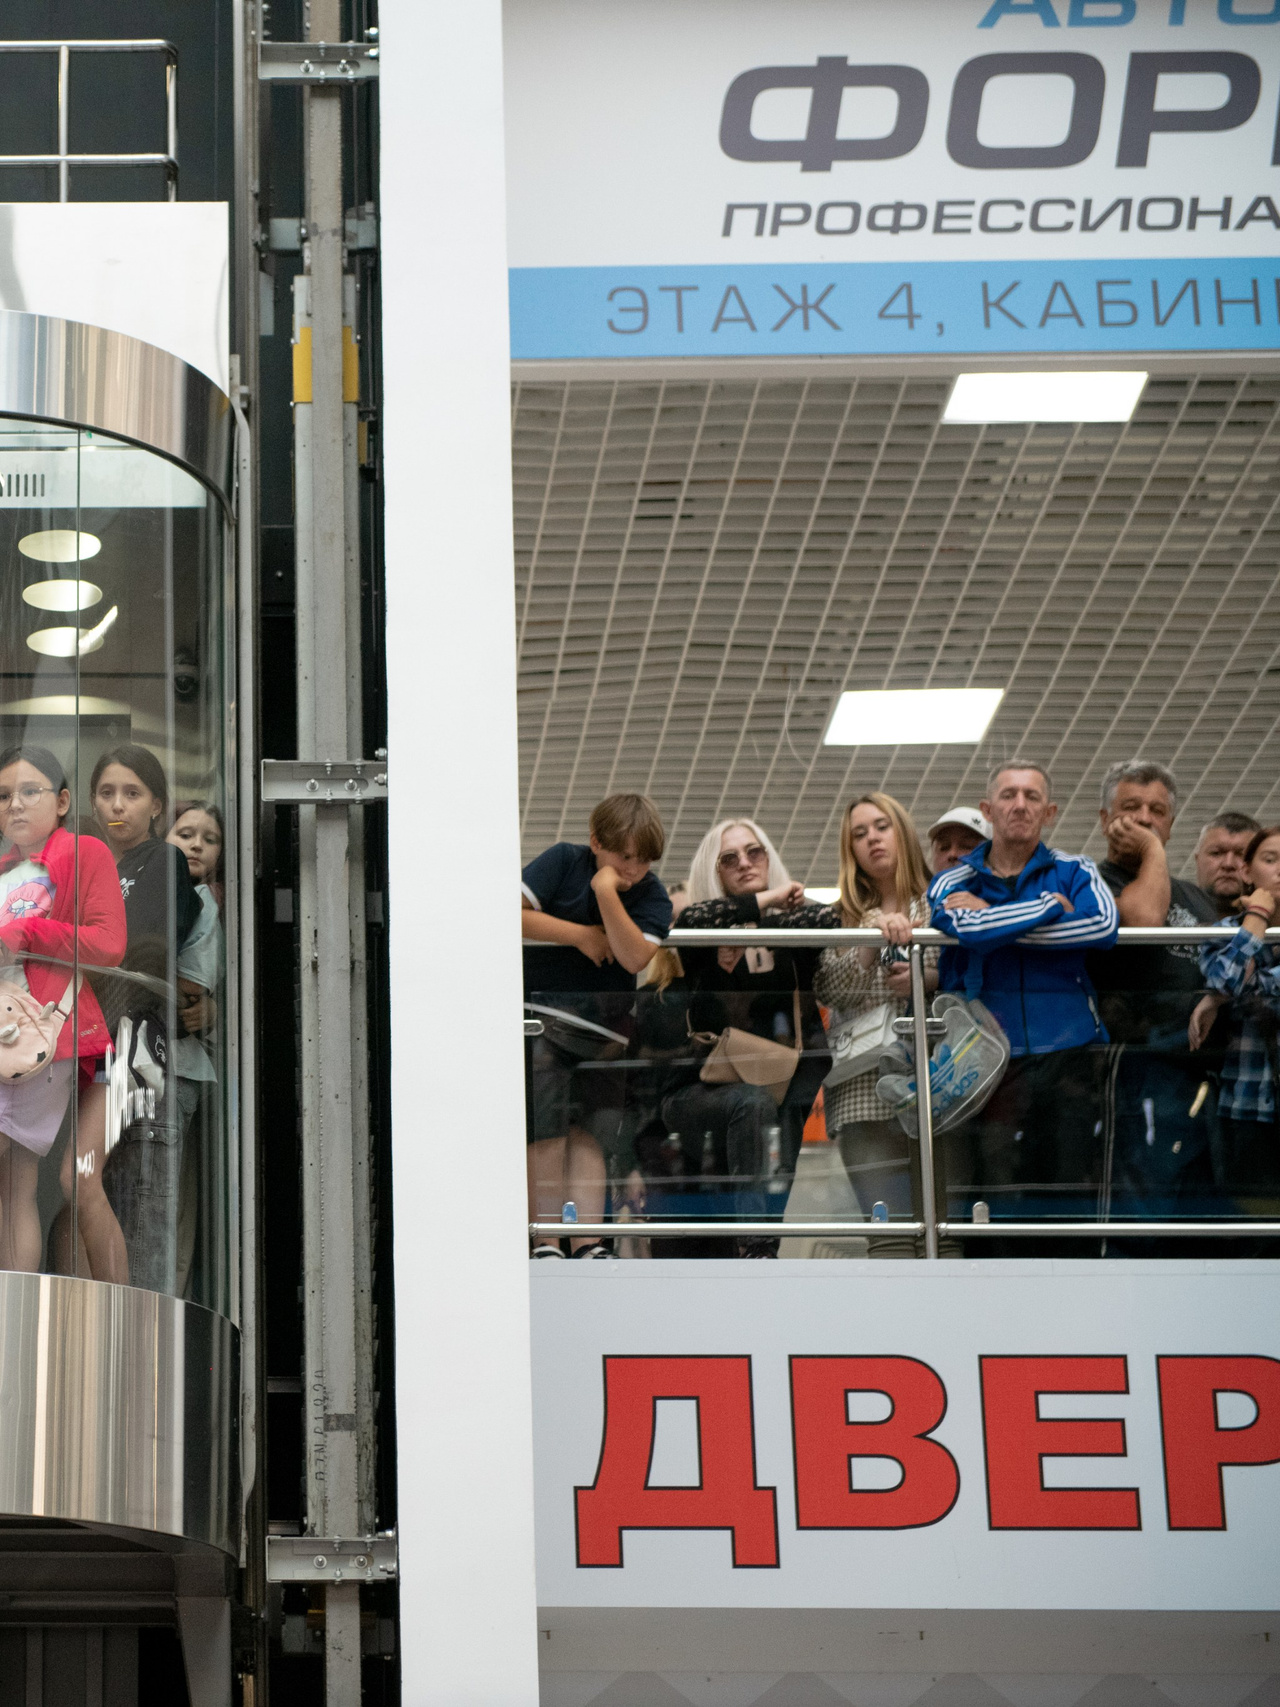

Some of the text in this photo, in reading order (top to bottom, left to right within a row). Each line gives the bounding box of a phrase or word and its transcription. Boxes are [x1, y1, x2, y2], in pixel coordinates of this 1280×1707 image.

[719, 50, 1280, 172] ФОР
[721, 195, 1280, 237] ПРОФЕССИОНА
[607, 277, 1280, 337] ЭТАЖ 4, КАБИН
[931, 1069, 979, 1118] adidas
[573, 1354, 1280, 1568] ДВЕР
